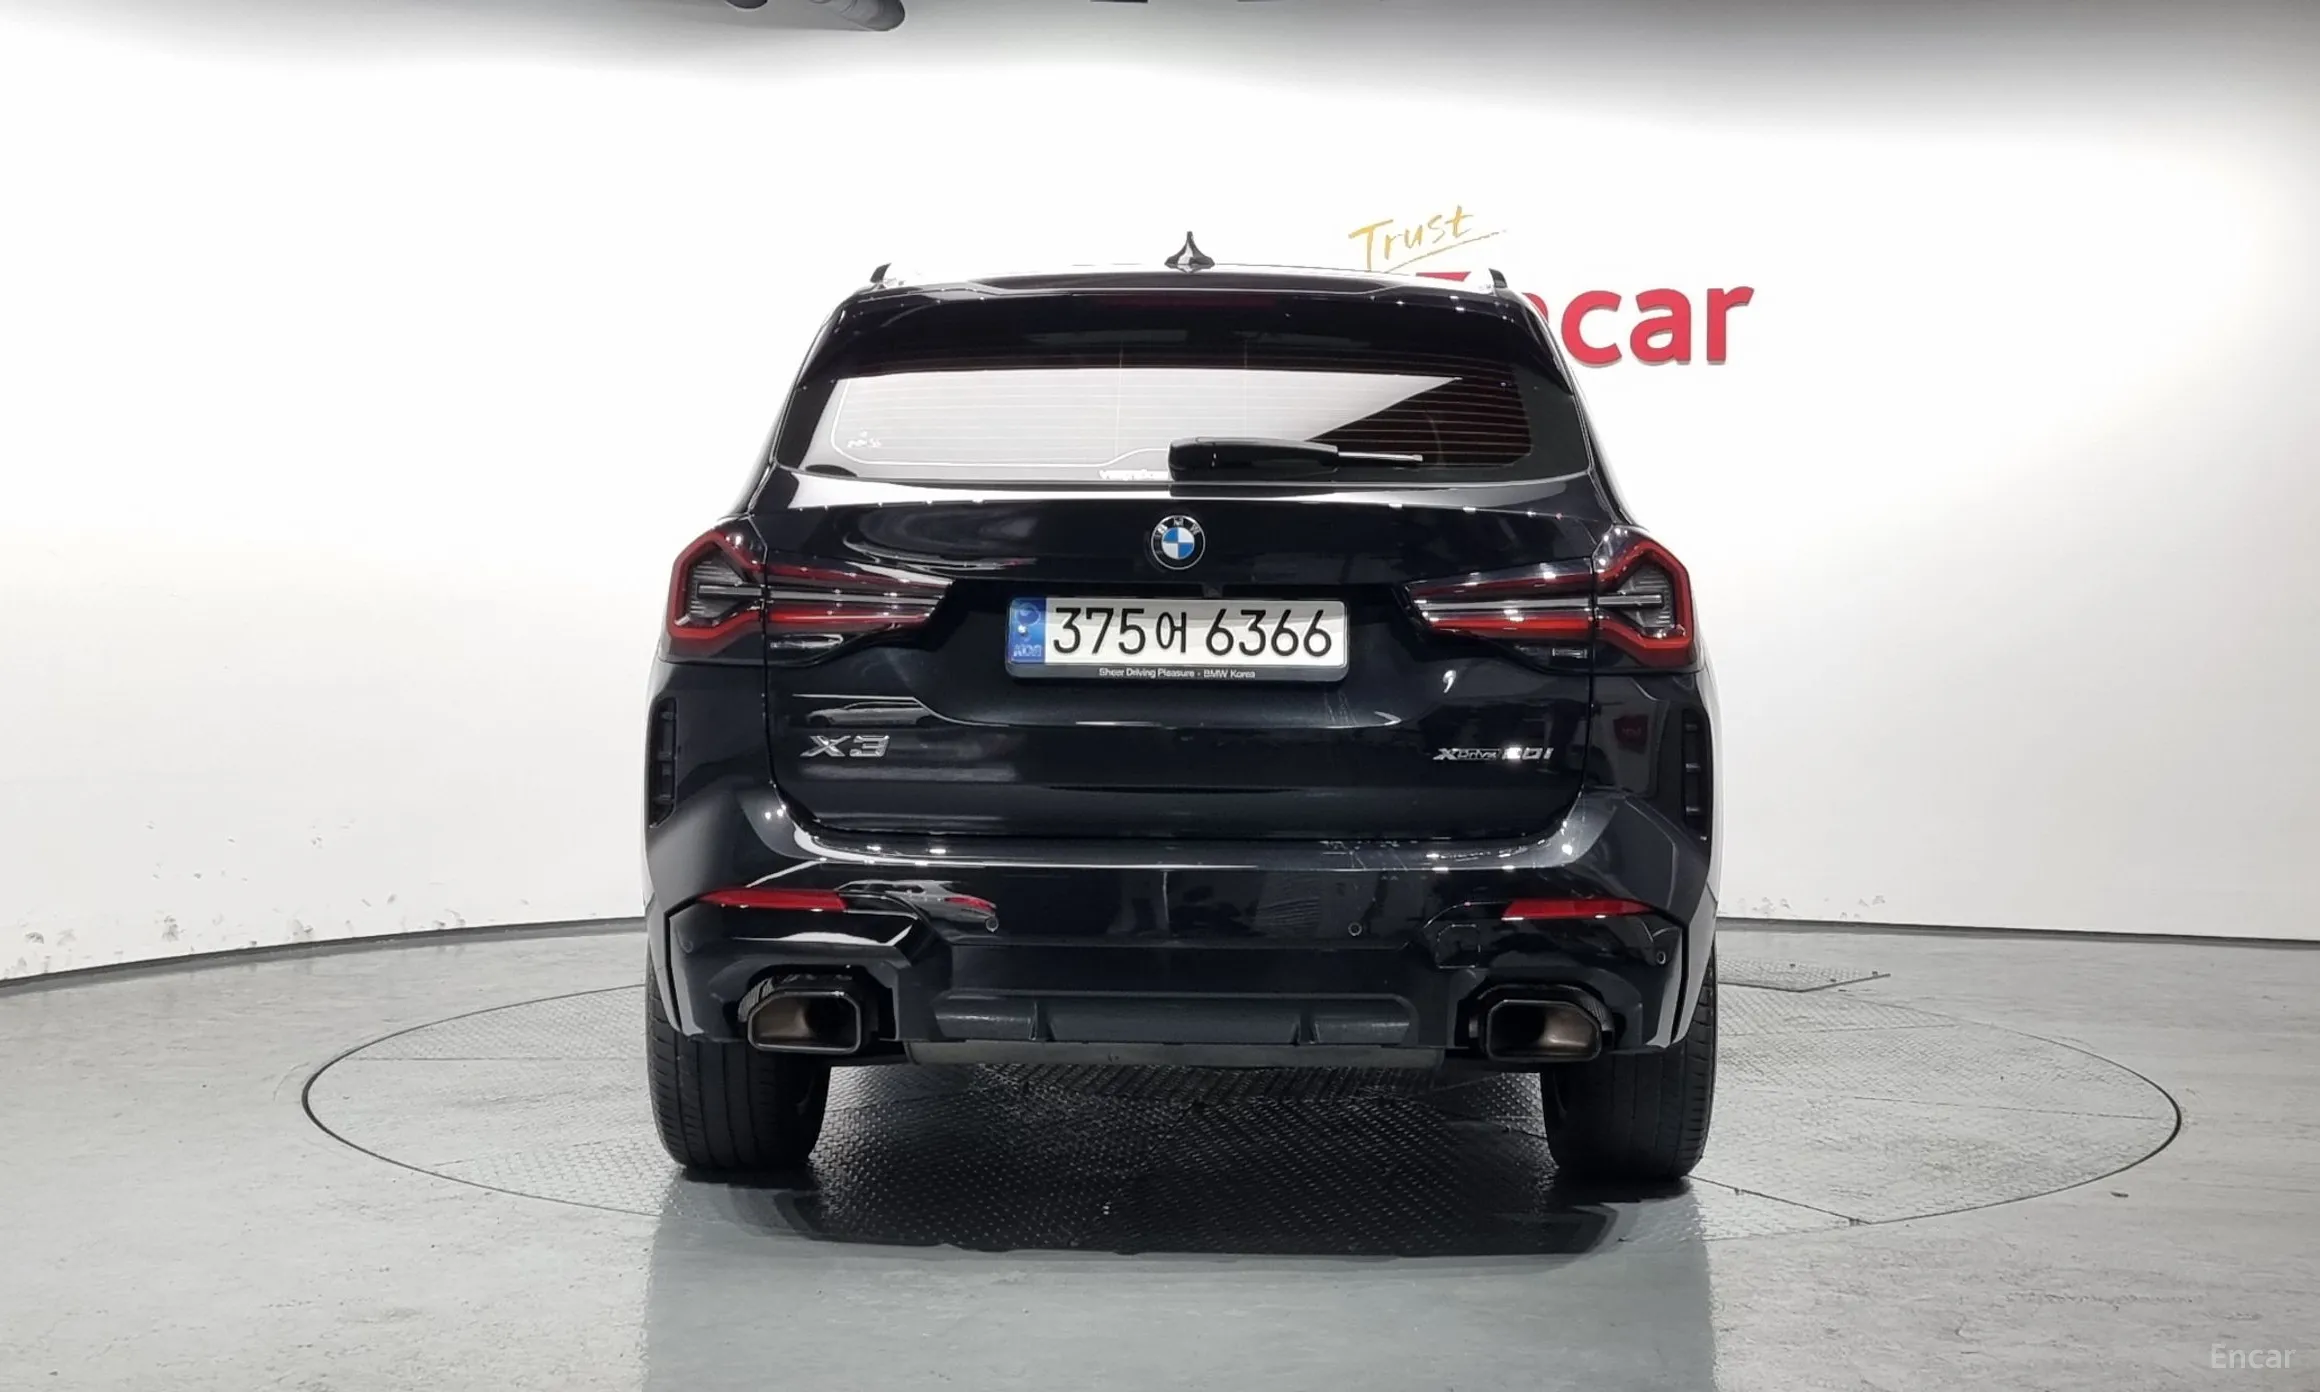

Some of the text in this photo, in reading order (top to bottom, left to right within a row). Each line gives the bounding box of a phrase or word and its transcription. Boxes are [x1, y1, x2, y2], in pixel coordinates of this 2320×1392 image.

[1348, 205, 1475, 272] Trust
[1416, 271, 1755, 366] car
[1053, 607, 1332, 657] 375어 6366
[1126, 668, 1157, 679] Driving
[1158, 668, 1195, 678] Pleasure
[1204, 669, 1229, 678] BMW
[1230, 669, 1256, 679] Korea
[800, 735, 890, 757] X3
